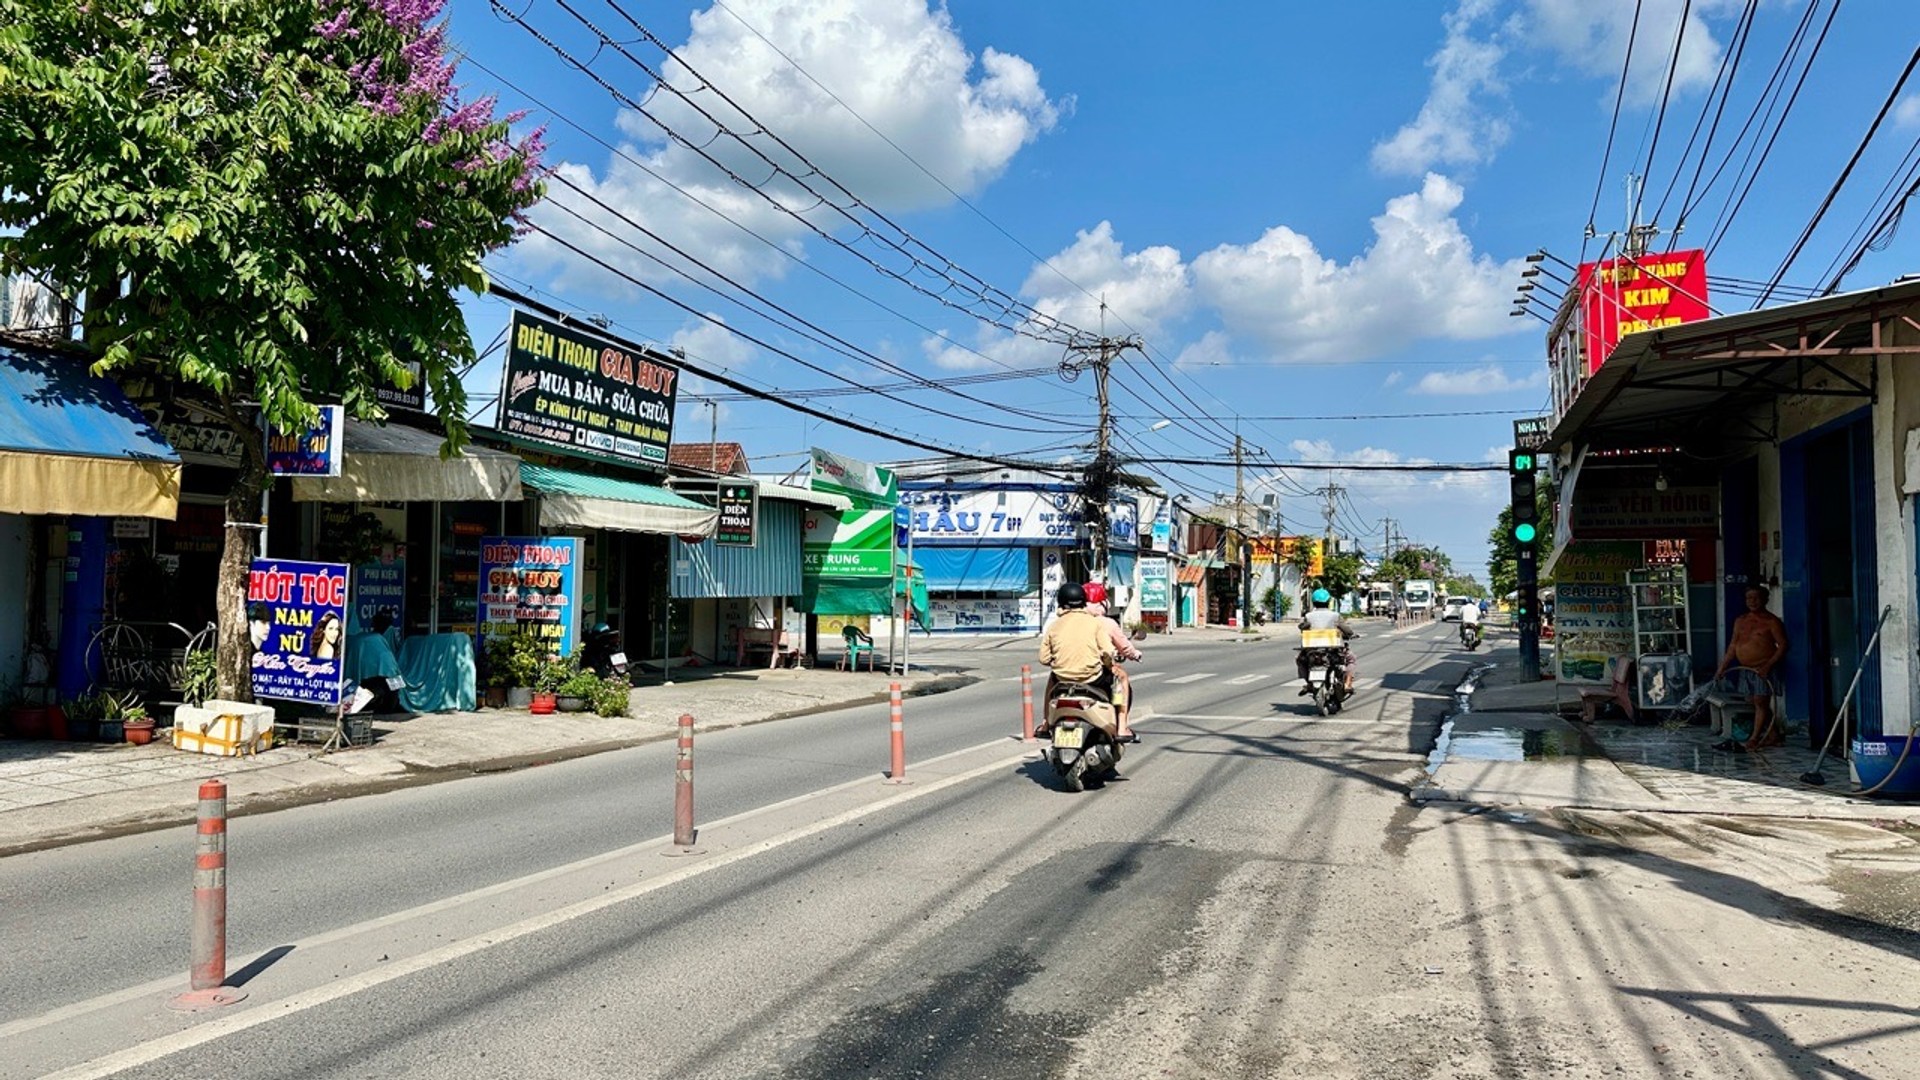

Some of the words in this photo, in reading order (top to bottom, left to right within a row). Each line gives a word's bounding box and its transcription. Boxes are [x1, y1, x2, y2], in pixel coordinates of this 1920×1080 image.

[1646, 261, 1687, 279] VÀNG
[1623, 287, 1670, 307] KIM
[517, 324, 555, 361] ĐIỆN
[558, 338, 598, 376] THOẠI
[600, 348, 634, 385] GIA
[636, 360, 676, 397] HUY
[538, 370, 571, 397] MUA
[573, 379, 604, 406] BÁN
[611, 388, 636, 415] SỬA
[639, 401, 670, 424] CHỮA
[535, 395, 548, 412] ÉP
[549, 400, 571, 419] KÍNH
[571, 404, 588, 422] LẤY
[588, 411, 610, 428] NGAY
[615, 418, 634, 434] THAY
[270, 435, 299, 453] NAM
[1515, 455, 1531, 470] 04
[721, 516, 750, 527] THOẠI
[991, 513, 1006, 532] 7
[523, 544, 571, 569] THOẠI
[804, 554, 818, 564] XE
[821, 554, 860, 564] TRUNG
[300, 568, 344, 607] TÓC
[489, 571, 519, 587] GIA
[524, 571, 562, 588] HUY
[274, 607, 313, 627] NAM
[541, 624, 566, 637] NGAY
[279, 631, 305, 653] NỮ
[294, 677, 304, 686] TAI
